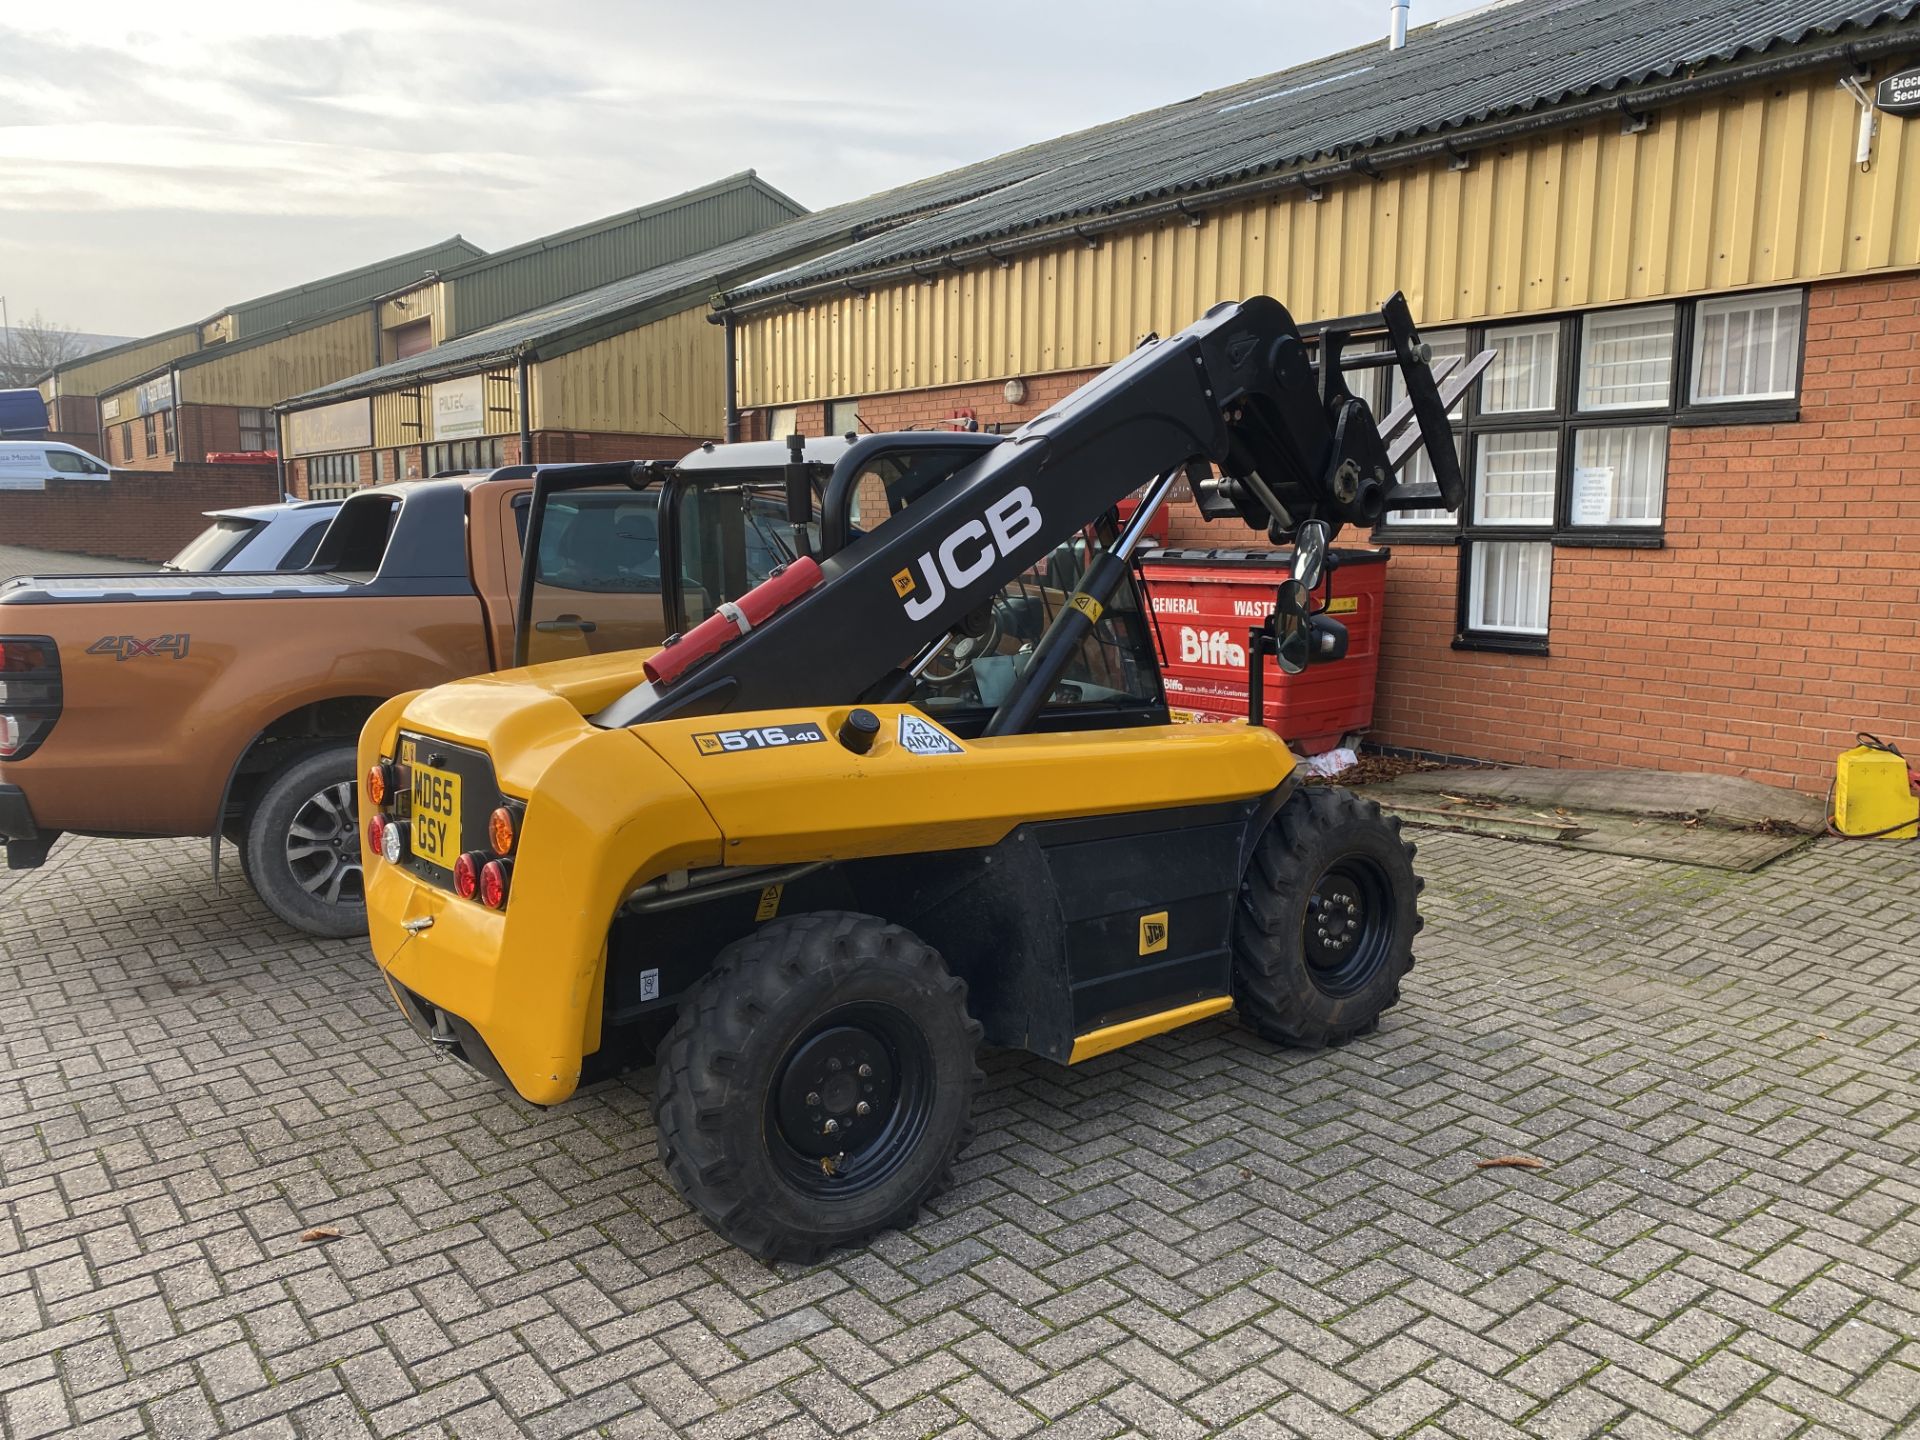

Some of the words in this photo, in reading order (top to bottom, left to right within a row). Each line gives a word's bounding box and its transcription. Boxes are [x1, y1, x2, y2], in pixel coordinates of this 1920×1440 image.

[440, 392, 464, 411] PILTEC
[904, 486, 1042, 621] JCB
[896, 576, 911, 589] JCB
[1153, 598, 1199, 614] GENERAL
[1181, 626, 1245, 667] Biffa
[1163, 678, 1183, 691] Biffa
[907, 722, 929, 735] 21
[907, 734, 947, 749] AN2M
[414, 769, 453, 816] MD65
[418, 814, 446, 857] GSY
[1146, 924, 1165, 946] JCB
